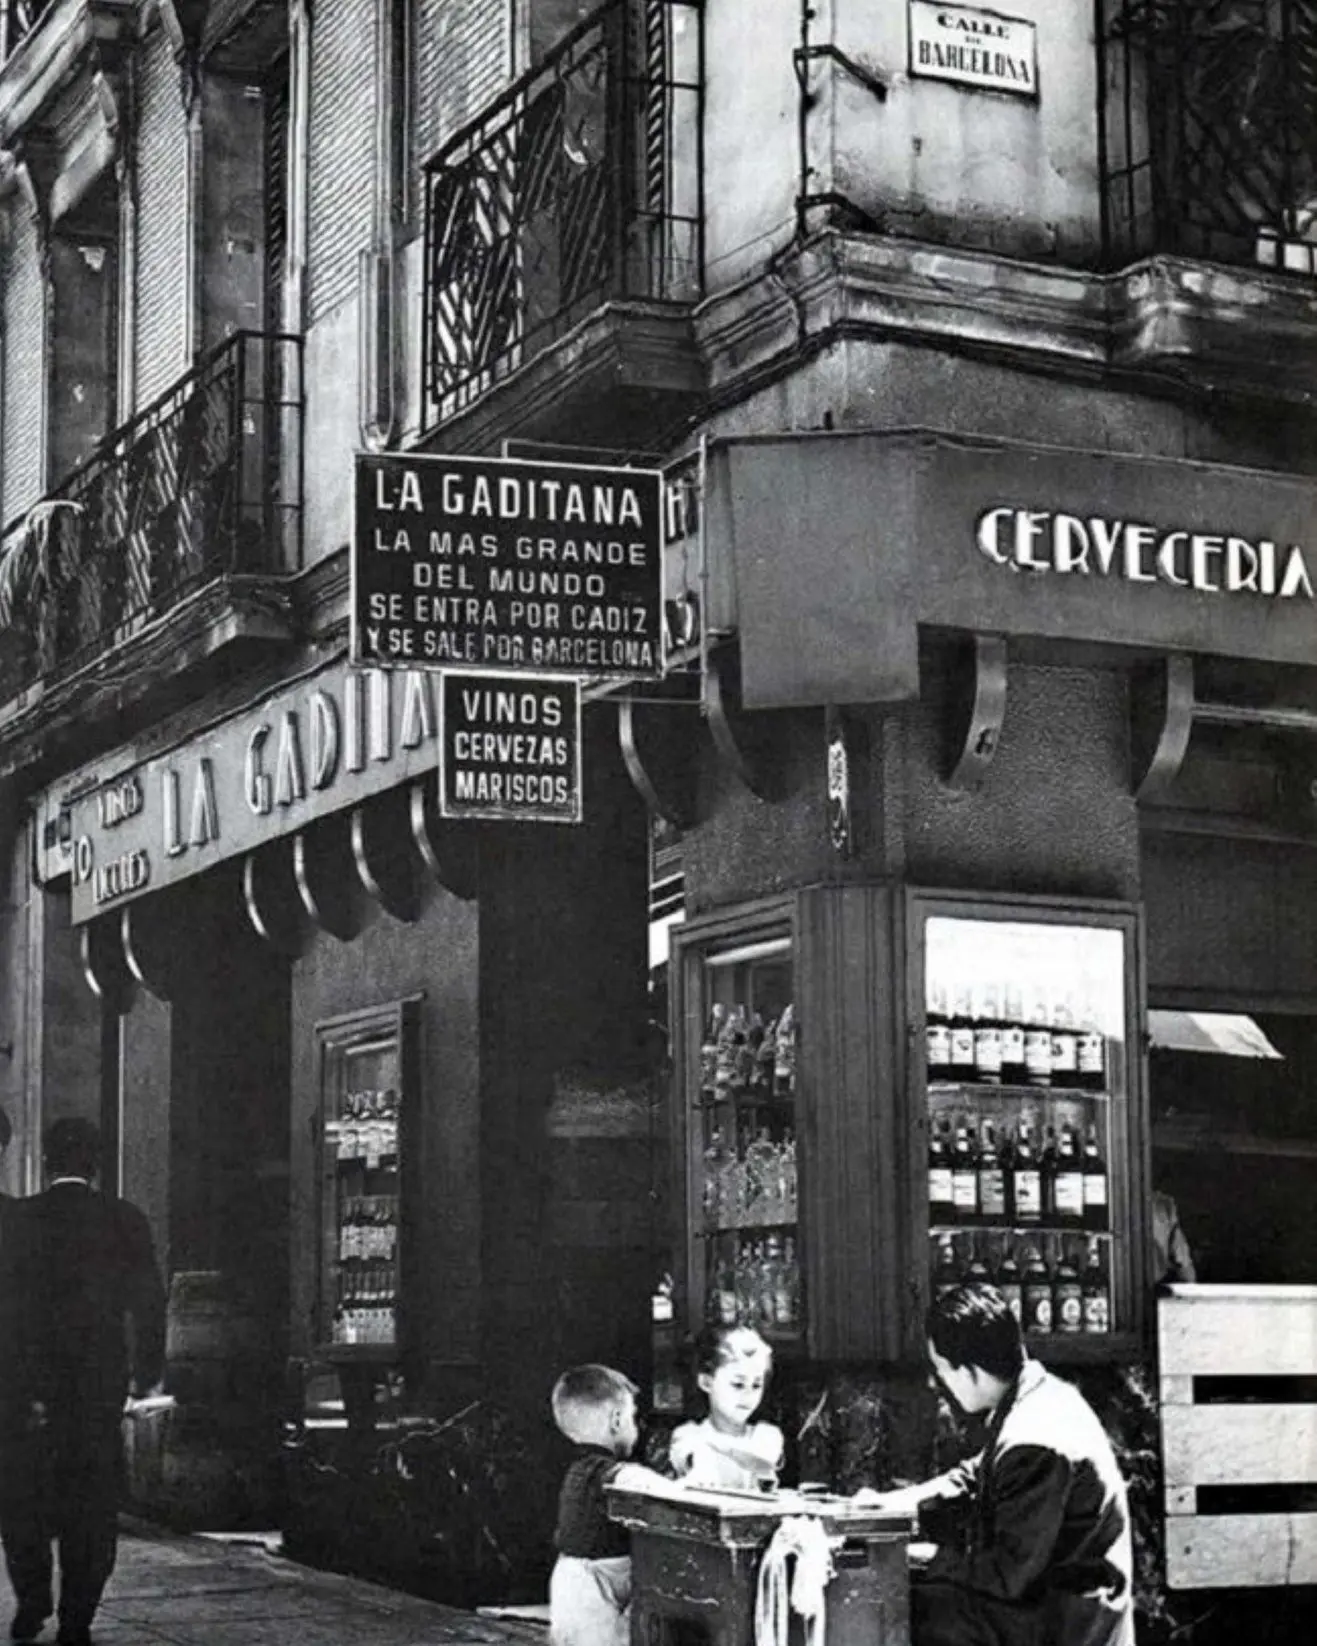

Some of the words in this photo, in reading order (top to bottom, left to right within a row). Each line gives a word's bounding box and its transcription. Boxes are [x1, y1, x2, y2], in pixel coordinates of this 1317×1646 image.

[937, 12, 1010, 40] CALLE
[919, 39, 1030, 84] BARCELONA
[376, 468, 423, 512] LA
[442, 473, 642, 528] GADITANA
[375, 527, 411, 552] LA
[429, 530, 498, 558] MAS
[516, 536, 646, 566] GRANDE
[977, 507, 1315, 598] CERVECERIA
[413, 562, 475, 590] DEL
[489, 566, 606, 597] MUNDO
[369, 592, 402, 621] SE
[414, 595, 498, 626] ENTRA
[510, 601, 560, 630] POR
[571, 604, 647, 634] CADIZ
[366, 626, 380, 652] Y
[388, 628, 414, 654] SE
[424, 631, 476, 662] SALE
[484, 634, 524, 662] POR
[531, 637, 653, 667] BARCELONA
[462, 689, 561, 726] VINOS
[163, 756, 220, 858] LA
[244, 669, 438, 816] GADITA
[454, 731, 567, 765] CERVEZAS
[456, 770, 568, 803] MARISCOS
